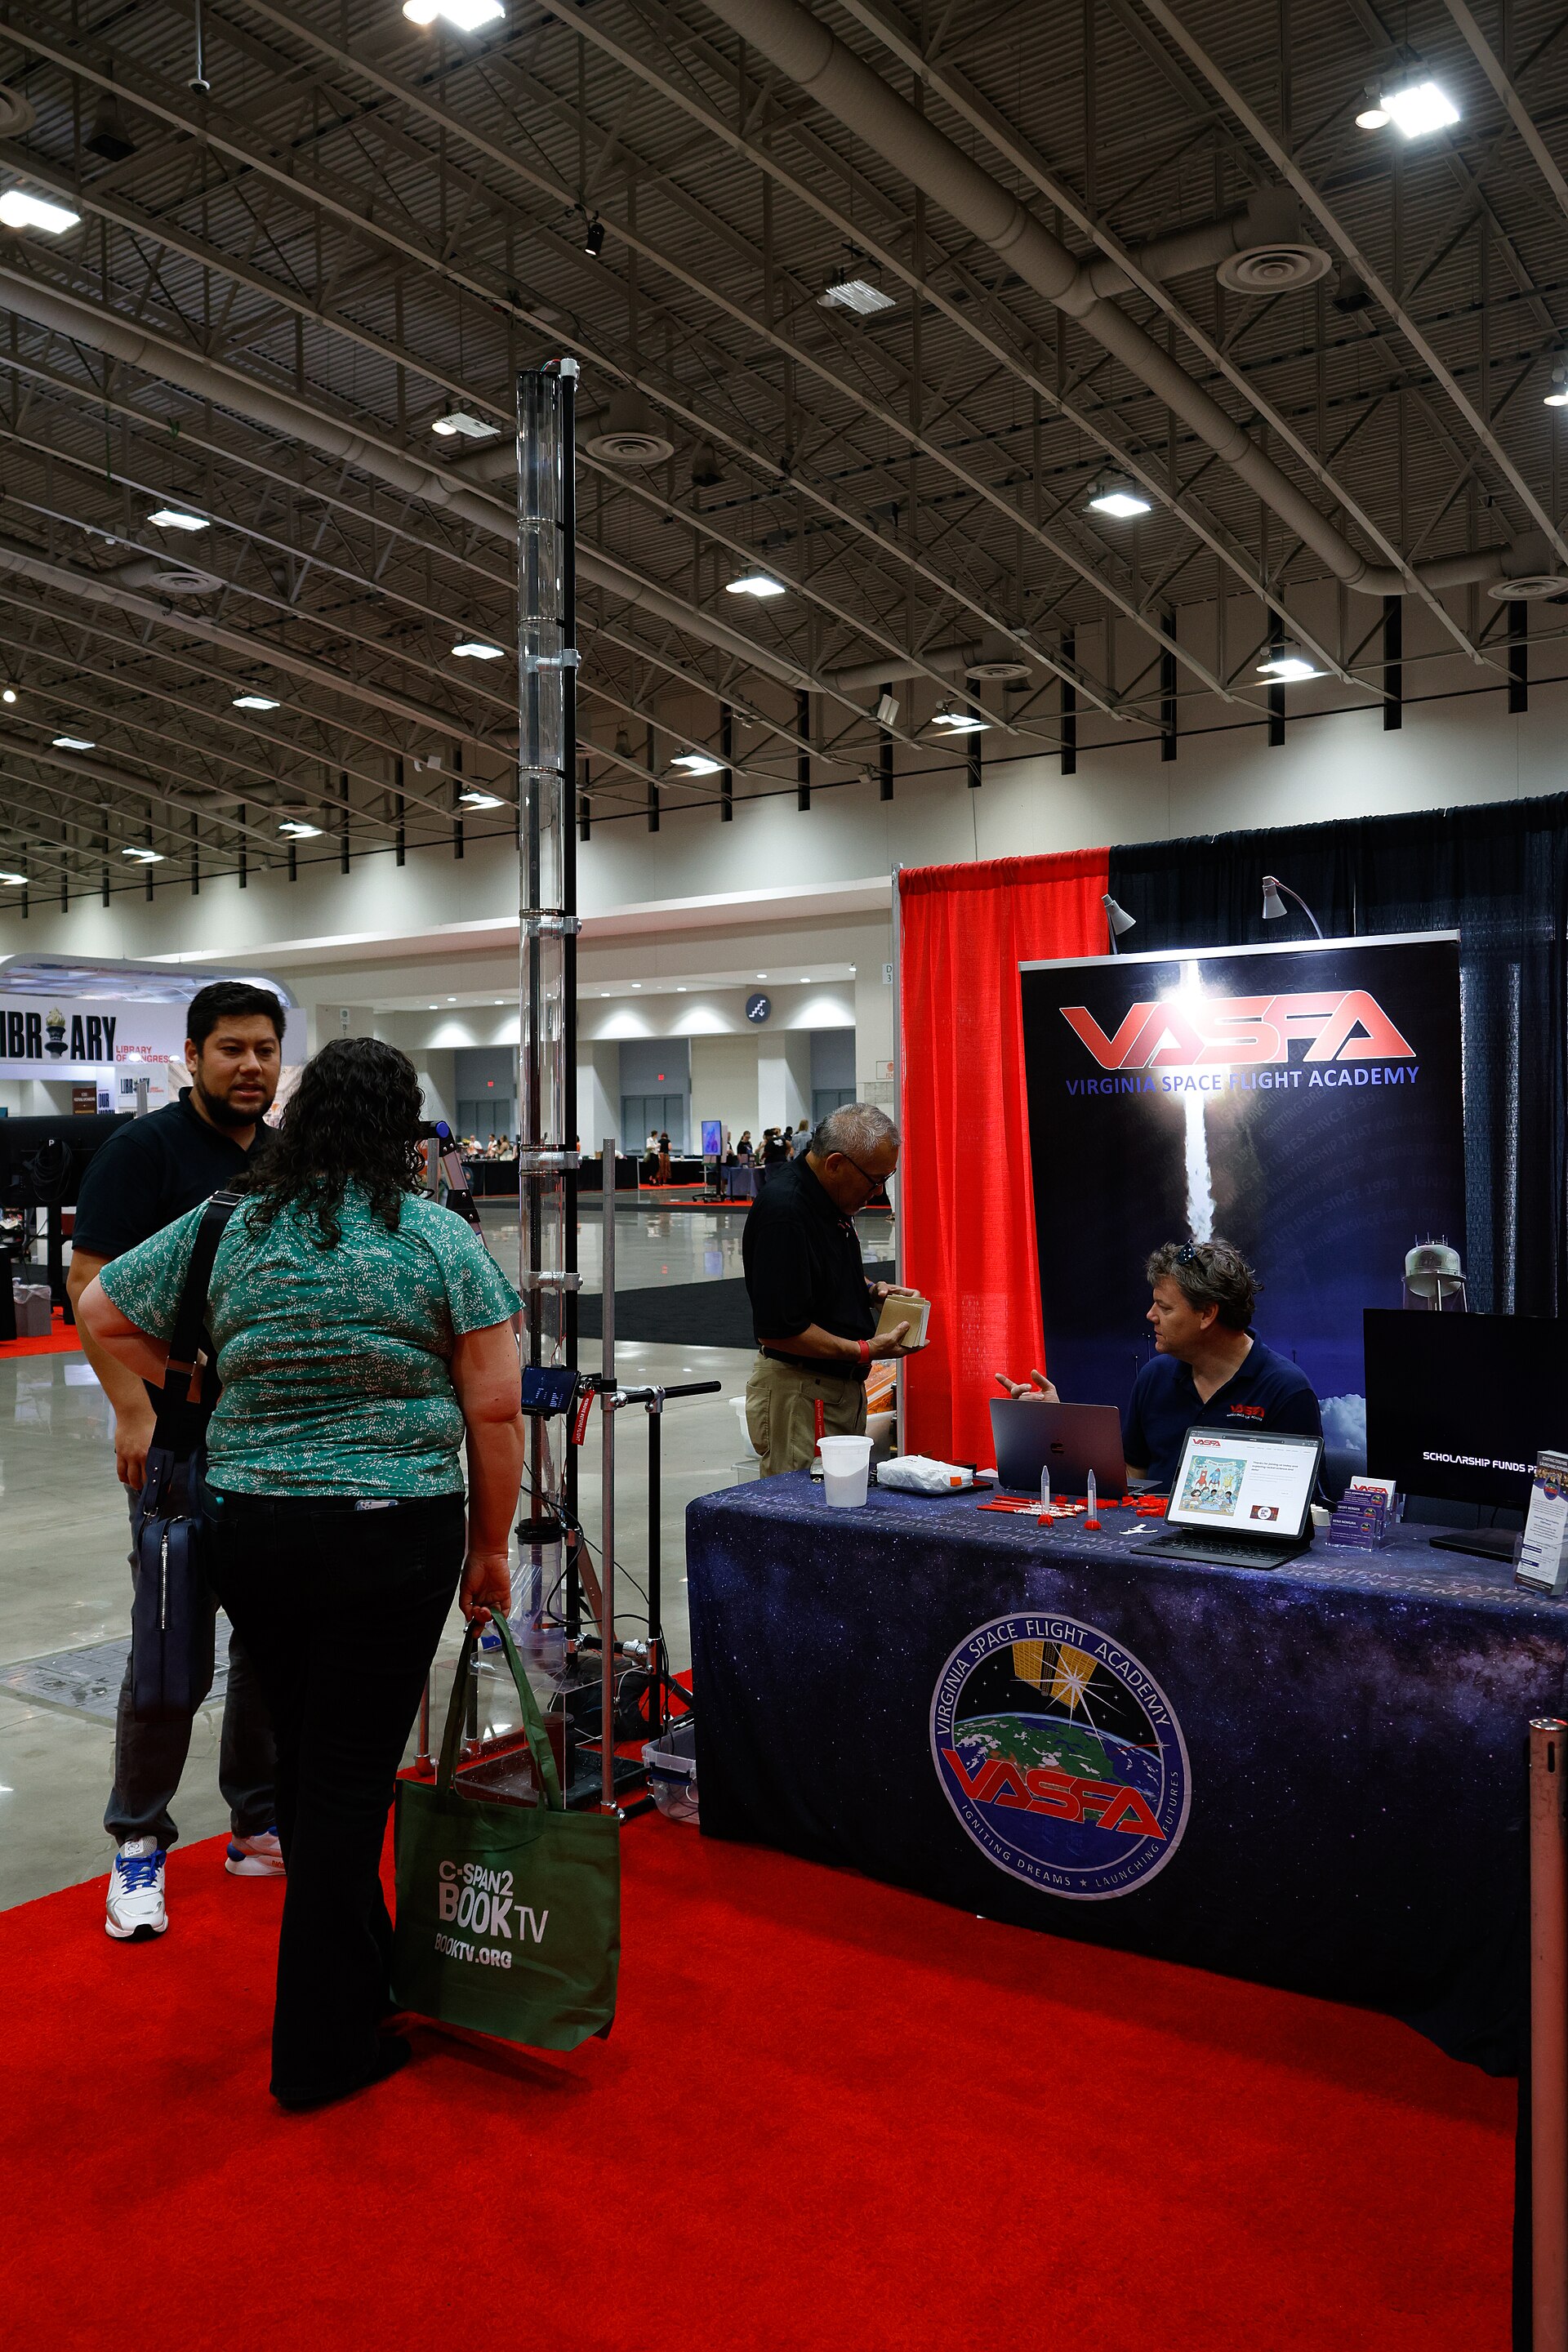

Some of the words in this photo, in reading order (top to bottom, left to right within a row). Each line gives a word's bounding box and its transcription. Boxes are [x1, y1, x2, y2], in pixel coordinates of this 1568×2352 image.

[1059, 990, 1417, 1070] VASFA
[116, 1045, 152, 1054] LIBRARY
[116, 1054, 127, 1062] OF
[1066, 1076, 1156, 1096] VIRGINIA
[1162, 1074, 1223, 1092] SPACE
[1229, 1070, 1303, 1090] FLIGHT
[1307, 1066, 1420, 1088] ACADEMY
[1423, 1450, 1490, 1468] SCHOLARSHIP
[1492, 1459, 1526, 1472] FUNDS
[911, 1515, 981, 1530] ACCESS
[987, 1524, 1013, 1533] TO
[888, 1518, 979, 1535] ADVANCE
[981, 1530, 1058, 1547] EQUITY
[1057, 1539, 1113, 1552] AND
[1388, 1582, 1461, 1597] STEM
[937, 1659, 970, 1735] VIRGINIA
[969, 1623, 1018, 1659] SPACE
[1026, 1620, 1089, 1646] FLIGHT
[1094, 1642, 1171, 1727] ACADEMY
[941, 1748, 1167, 1841] VASFA
[961, 1804, 1011, 1861] IGNITING
[1018, 1858, 1071, 1886] DREAMS
[1095, 1843, 1159, 1888] LAUNCHING
[1162, 1770, 1179, 1833] FUTURES
[439, 1860, 514, 1897] C-SPAN2
[439, 1882, 514, 1940] BOOK
[514, 1904, 549, 1944] TV
[434, 1932, 512, 1969] BOOKTV.ORG
